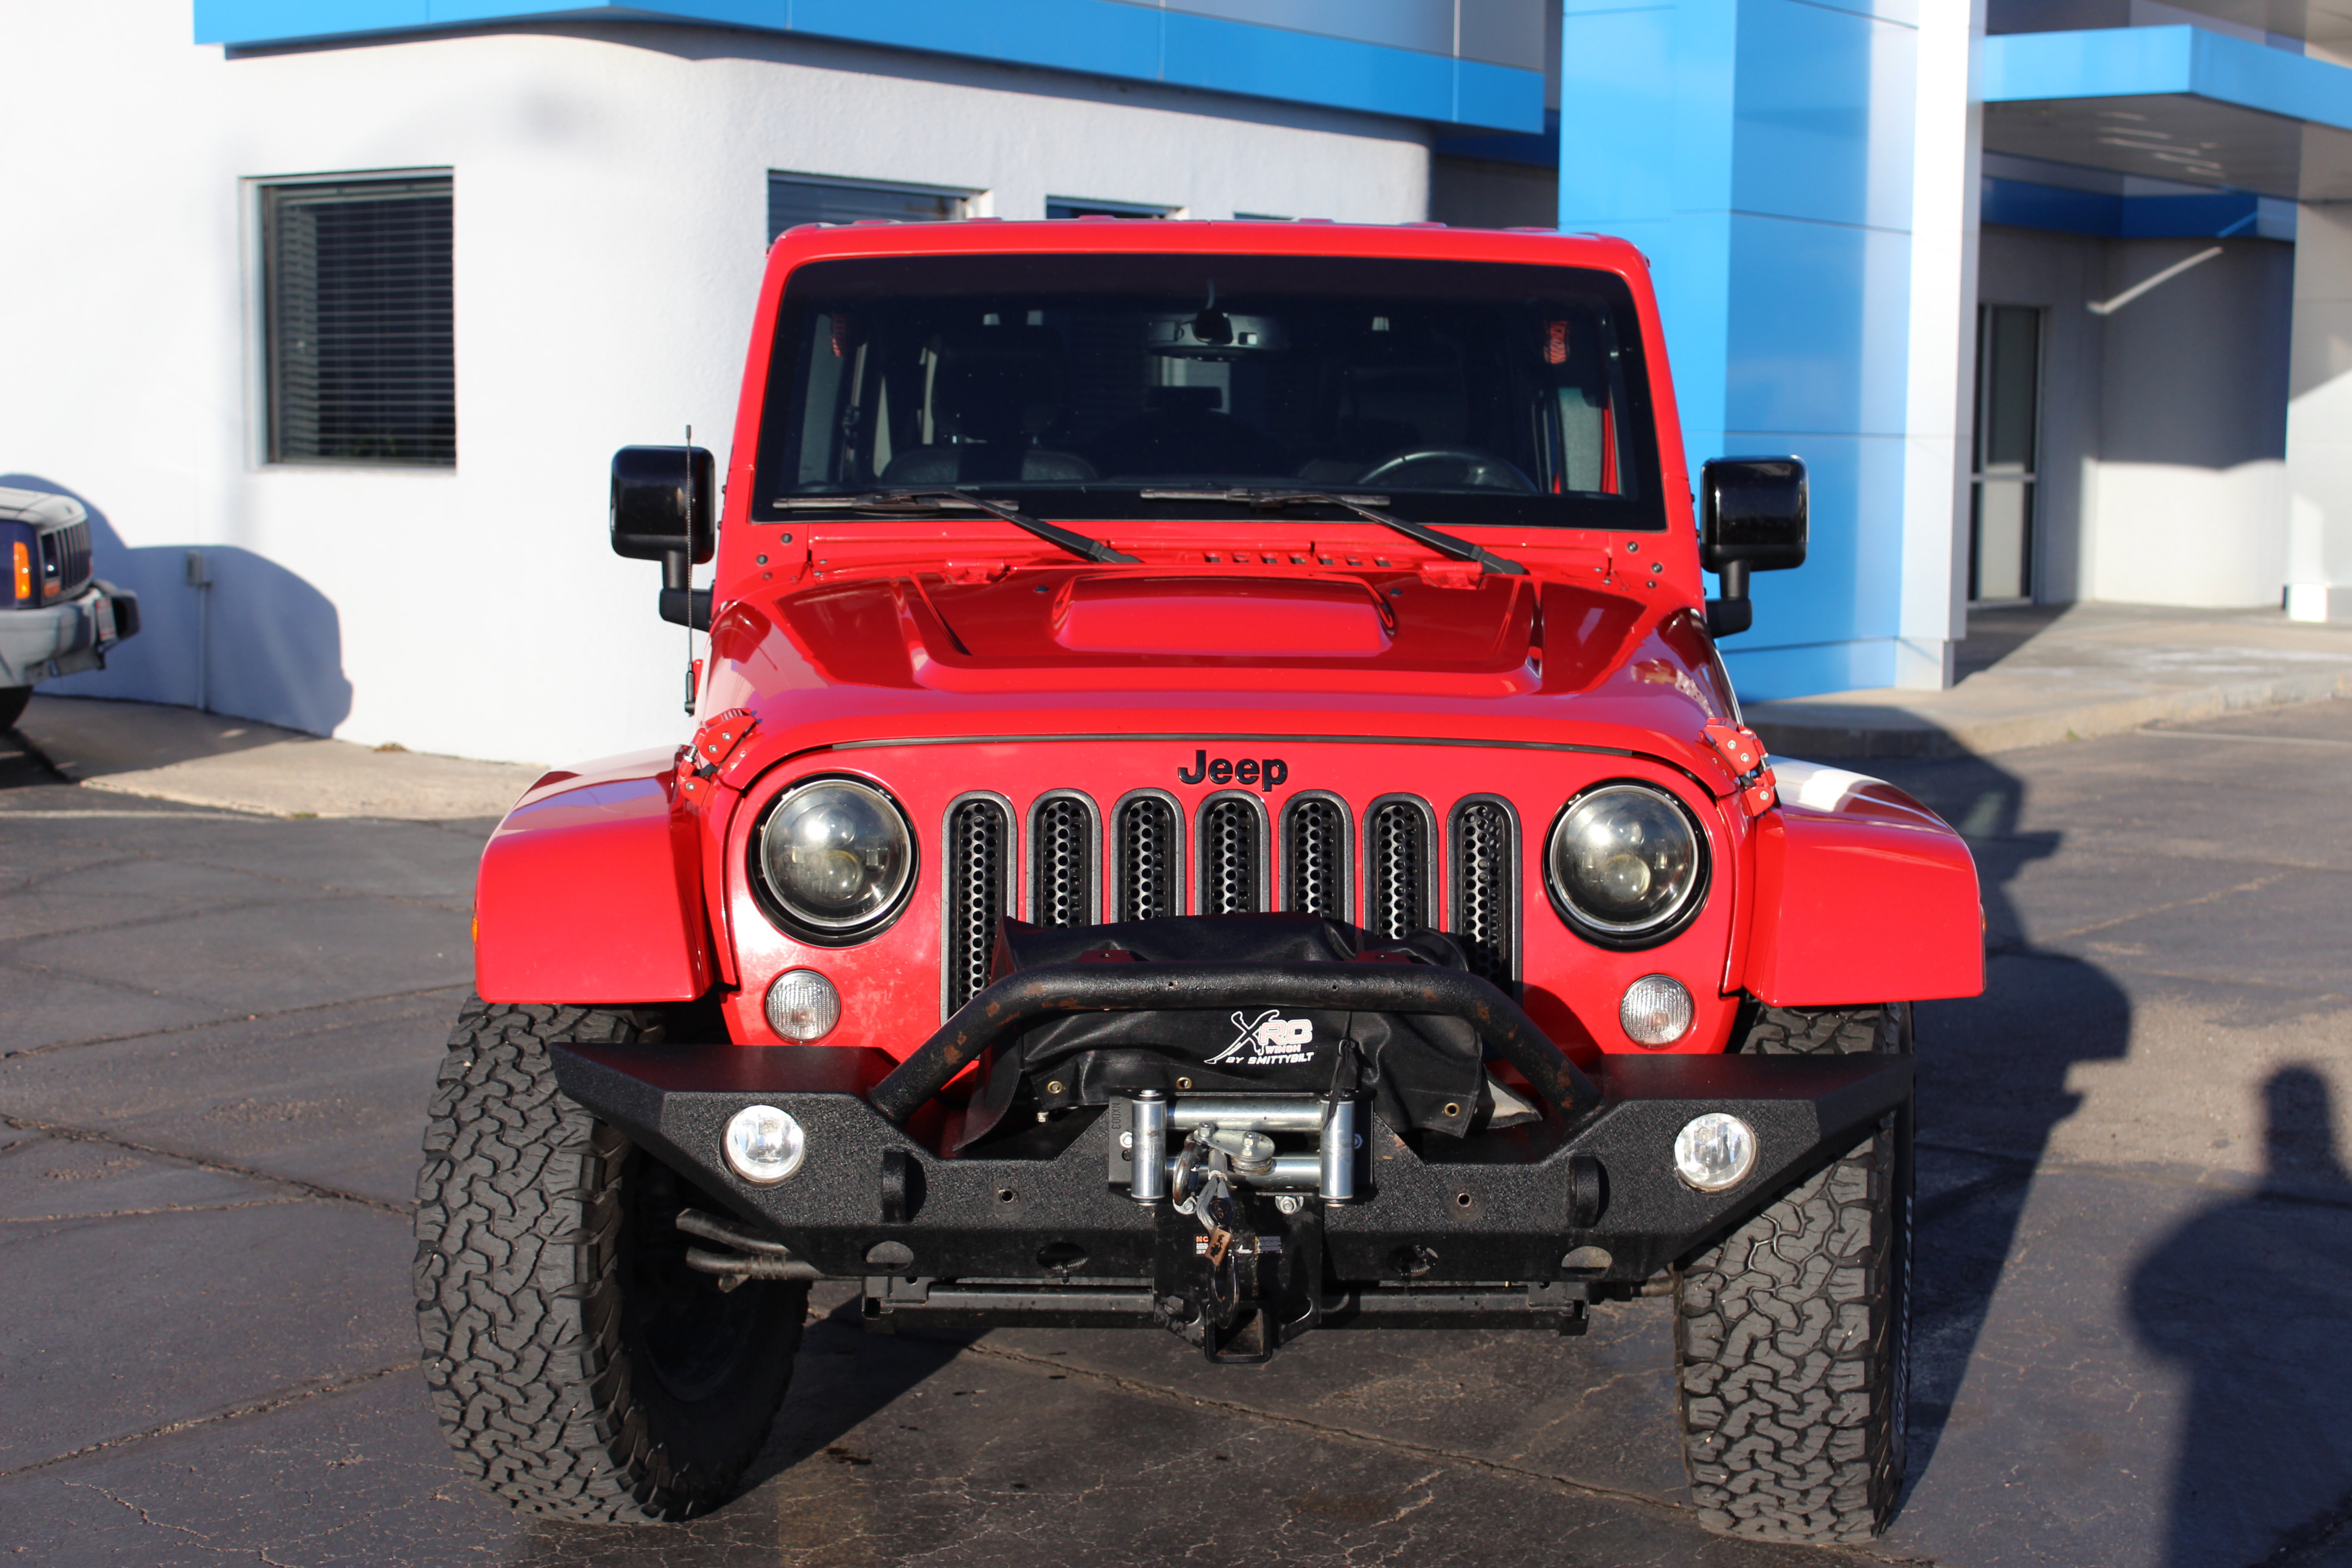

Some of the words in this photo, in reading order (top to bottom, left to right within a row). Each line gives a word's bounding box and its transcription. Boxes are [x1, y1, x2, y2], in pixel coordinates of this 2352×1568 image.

[1178, 750, 1288, 792] Jeep
[1204, 1009, 1313, 1064] XRC
[1248, 1052, 1314, 1064] SMITTYBILT
